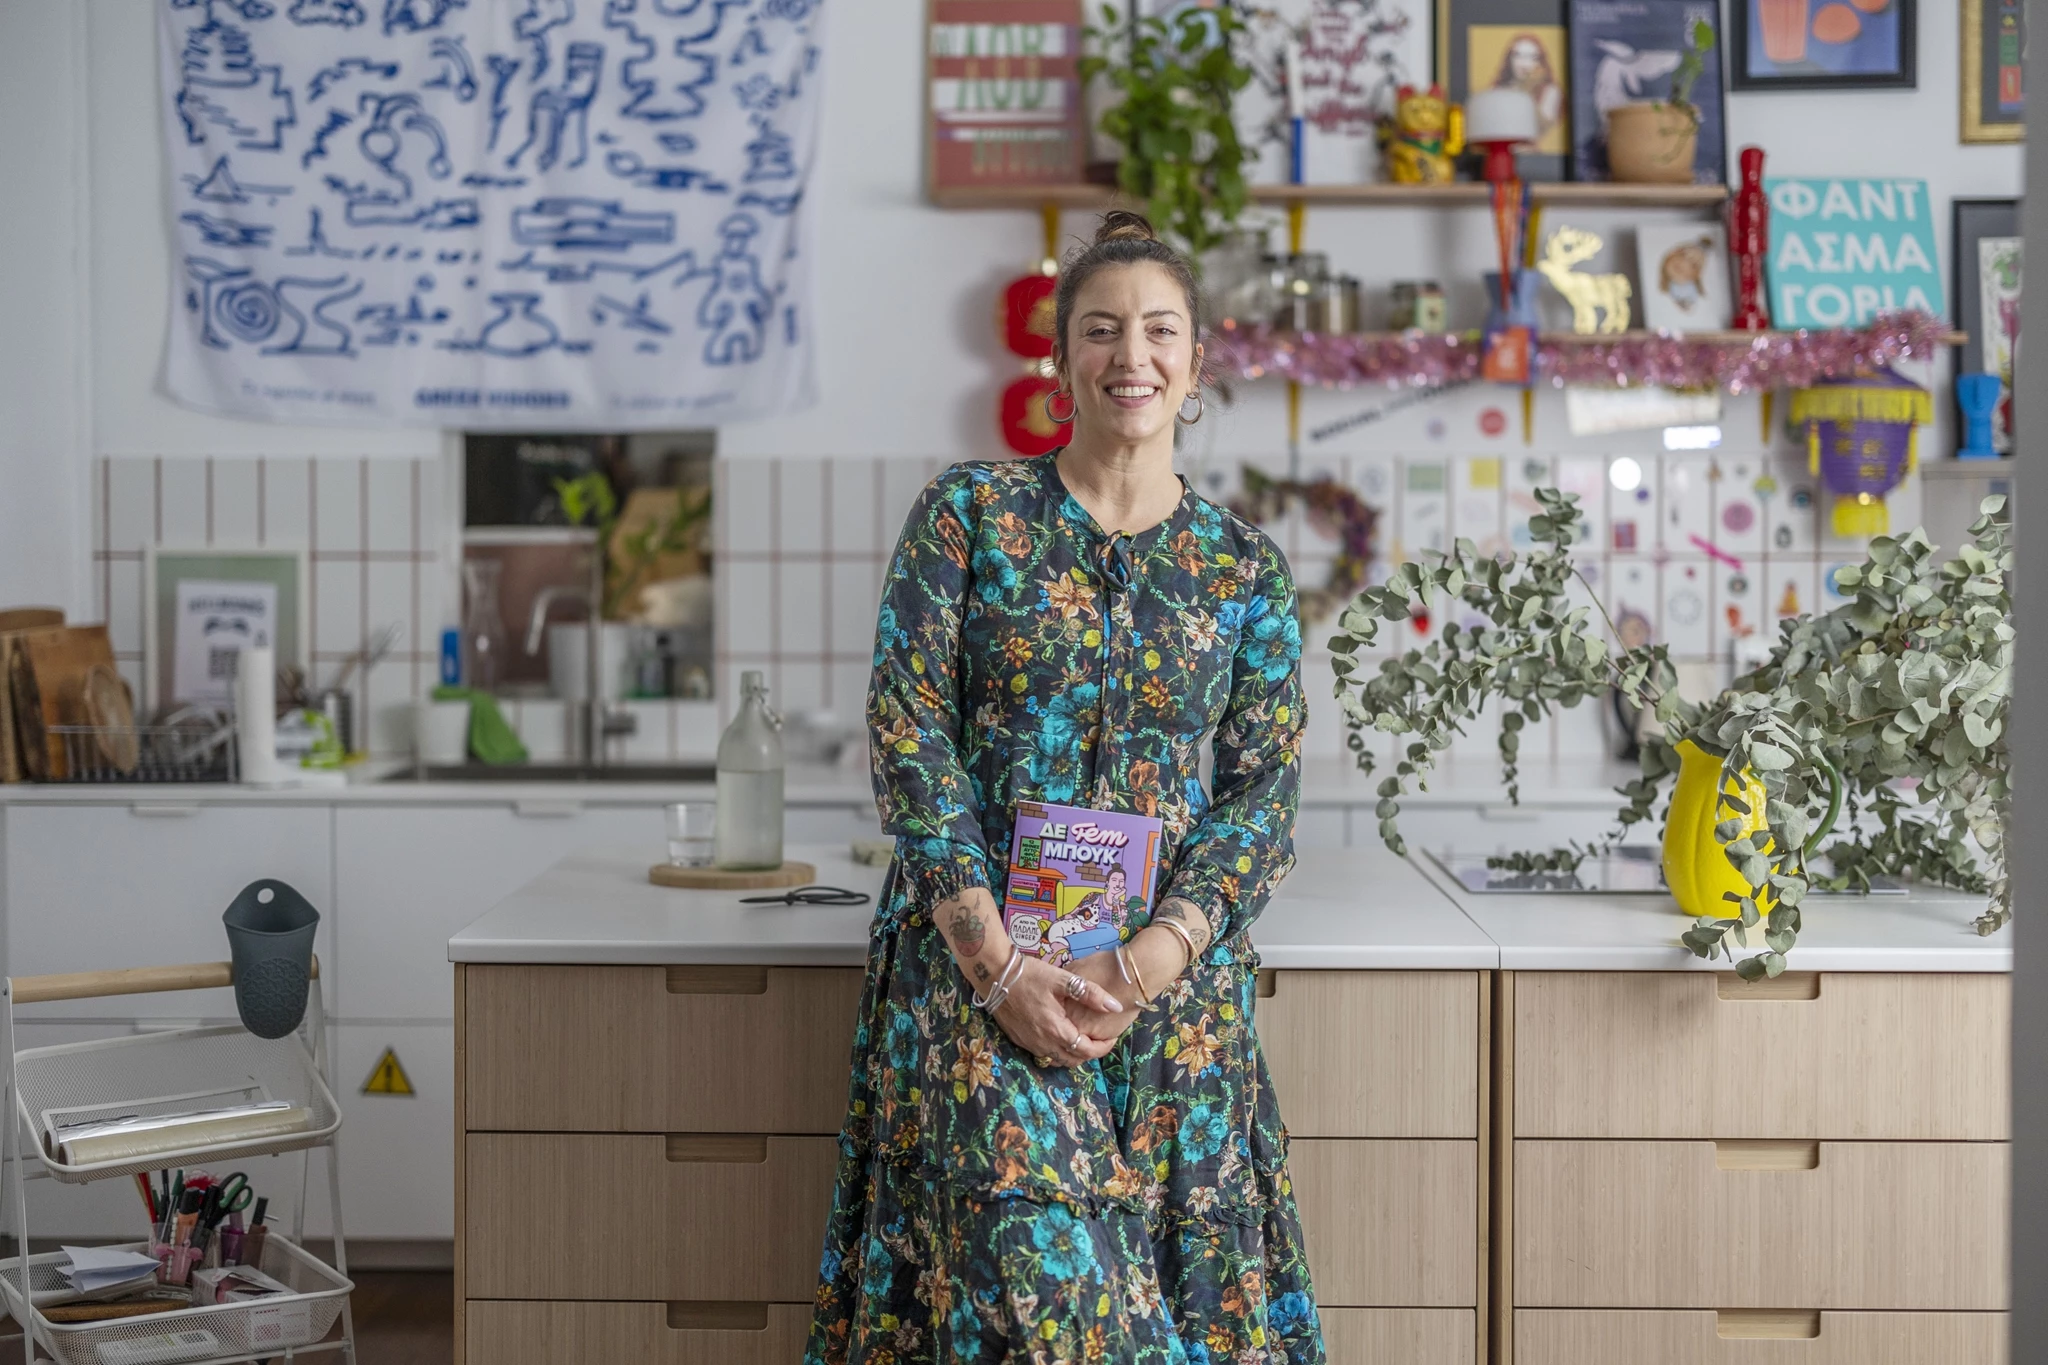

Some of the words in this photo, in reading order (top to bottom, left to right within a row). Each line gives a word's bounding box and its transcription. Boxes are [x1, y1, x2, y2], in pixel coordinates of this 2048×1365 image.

[1771, 181, 1921, 222] ΦΑΝΤ
[1777, 231, 1934, 274] ΑΣΜΑ
[1781, 283, 1935, 327] ΓΟΡΙΑ
[1039, 822, 1067, 841] ΔΕ
[1071, 823, 1129, 848] Fem
[1044, 841, 1119, 866] ΜΠΟΥΚ
[1012, 924, 1039, 936] MADAME
[1015, 933, 1037, 941] GINGER
